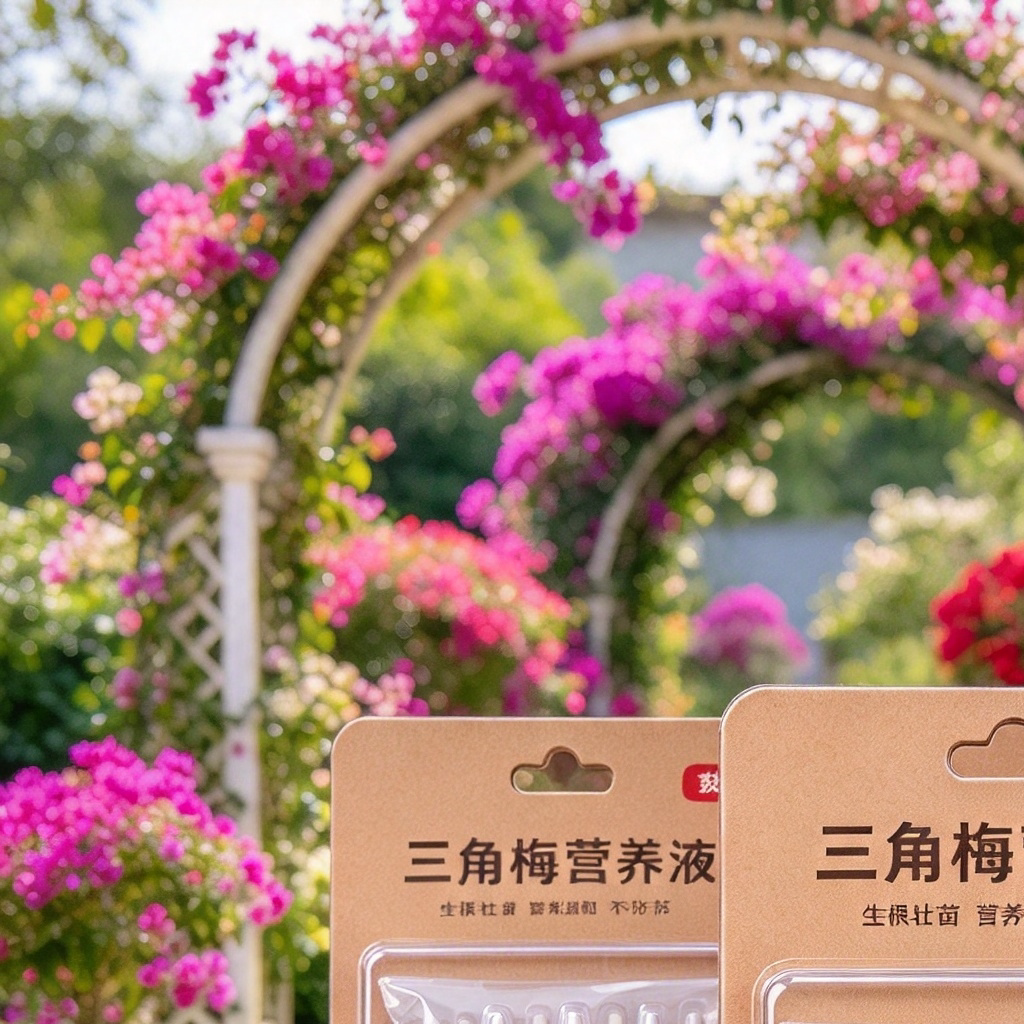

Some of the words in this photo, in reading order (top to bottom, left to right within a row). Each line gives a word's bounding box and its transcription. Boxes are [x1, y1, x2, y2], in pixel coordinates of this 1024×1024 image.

[404, 837, 717, 886] 三角梅营养液
